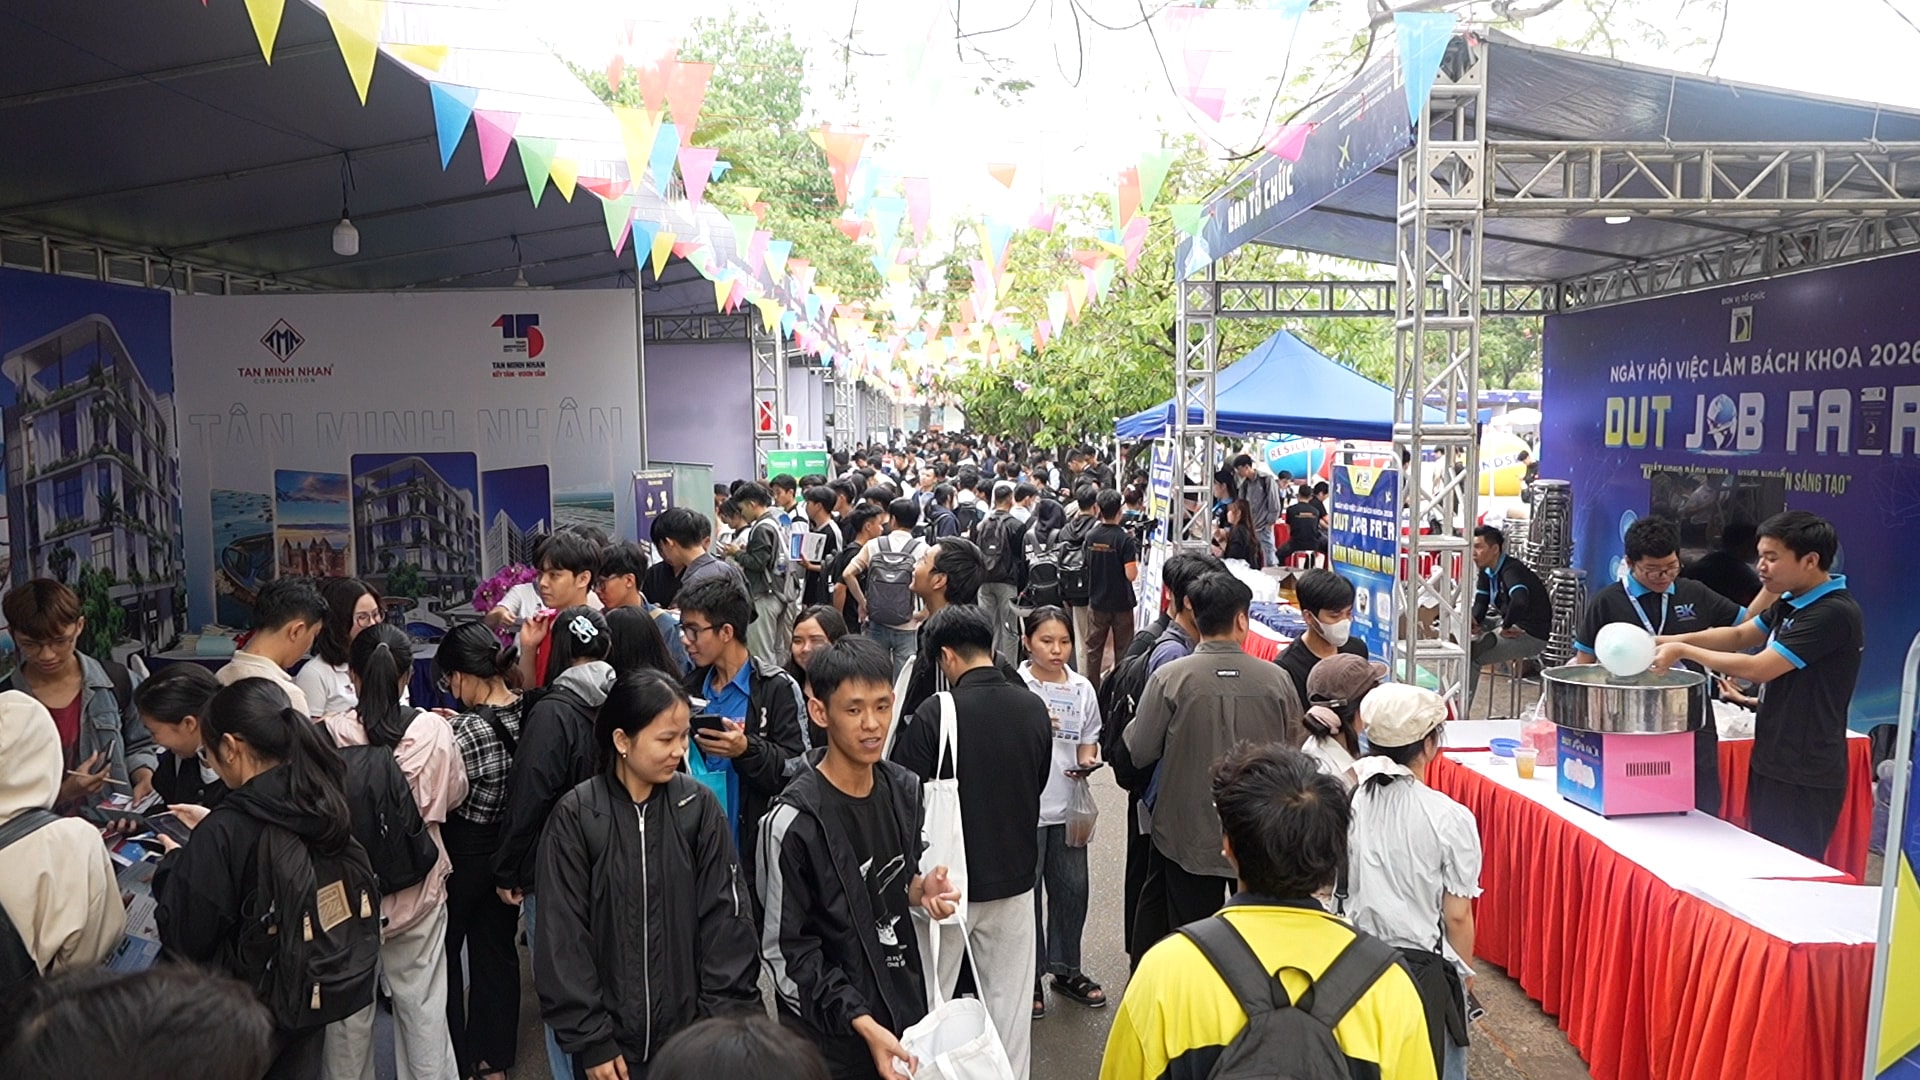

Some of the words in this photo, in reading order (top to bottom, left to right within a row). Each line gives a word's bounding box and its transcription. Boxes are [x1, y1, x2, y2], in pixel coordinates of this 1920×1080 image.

[238, 367, 261, 377] TAN
[265, 367, 294, 377] MINH
[298, 366, 332, 376] NHAN
[1610, 360, 1645, 383] NGÀY
[1648, 358, 1672, 384] HỘI
[1676, 355, 1709, 383] VIỆC
[1713, 352, 1746, 377] LÀM
[1751, 348, 1799, 375] BÁCH
[1805, 346, 1863, 371] KHOA
[1869, 341, 1920, 367] 2026
[188, 402, 295, 454] TÂN
[315, 410, 456, 454] MINH
[478, 397, 624, 456] NHÂN
[1604, 396, 1673, 449] DUT
[1685, 392, 1767, 453] JOB
[1795, 469, 1823, 493] SÁNG
